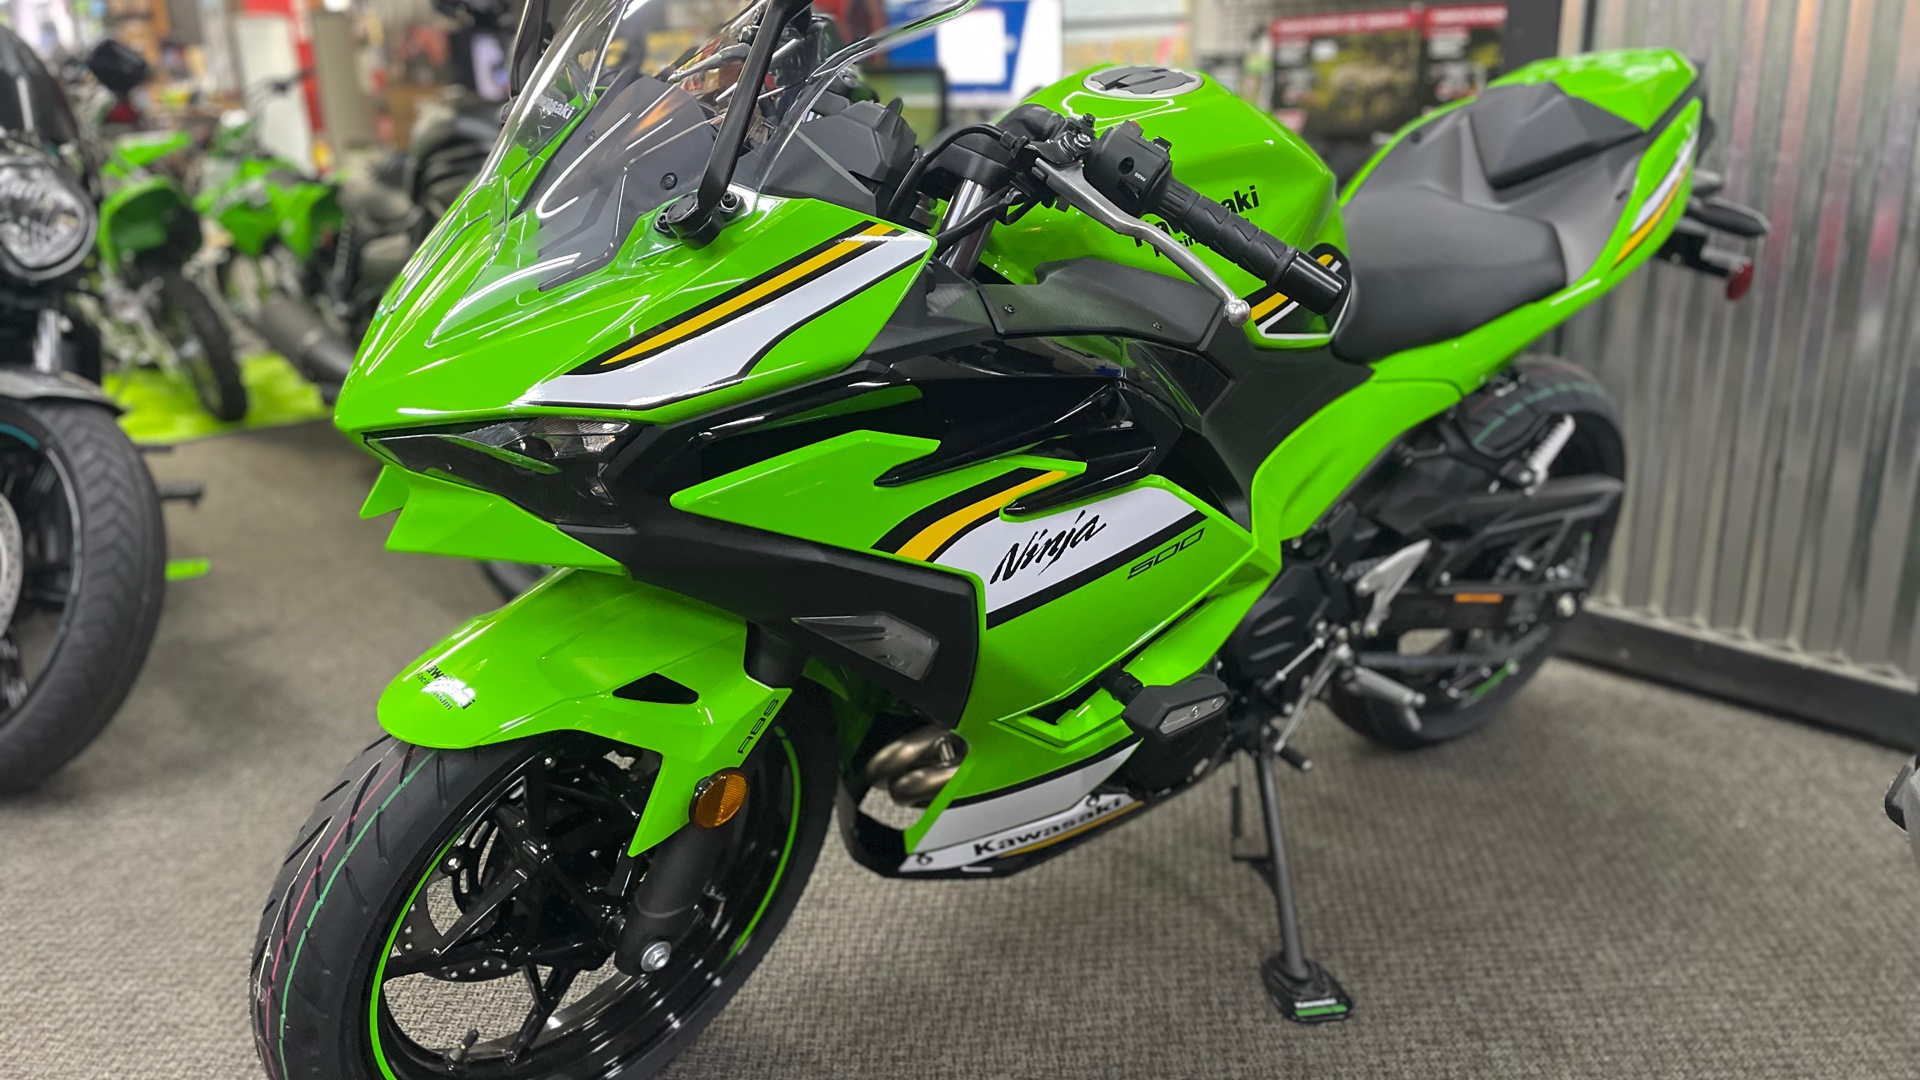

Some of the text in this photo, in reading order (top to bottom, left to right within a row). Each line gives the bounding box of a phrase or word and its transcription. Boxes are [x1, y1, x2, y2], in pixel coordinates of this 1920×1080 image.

[989, 509, 1107, 585] Ninja
[1127, 527, 1205, 580] 500
[738, 698, 779, 754] ABS
[973, 796, 1122, 856] Kawasaki
